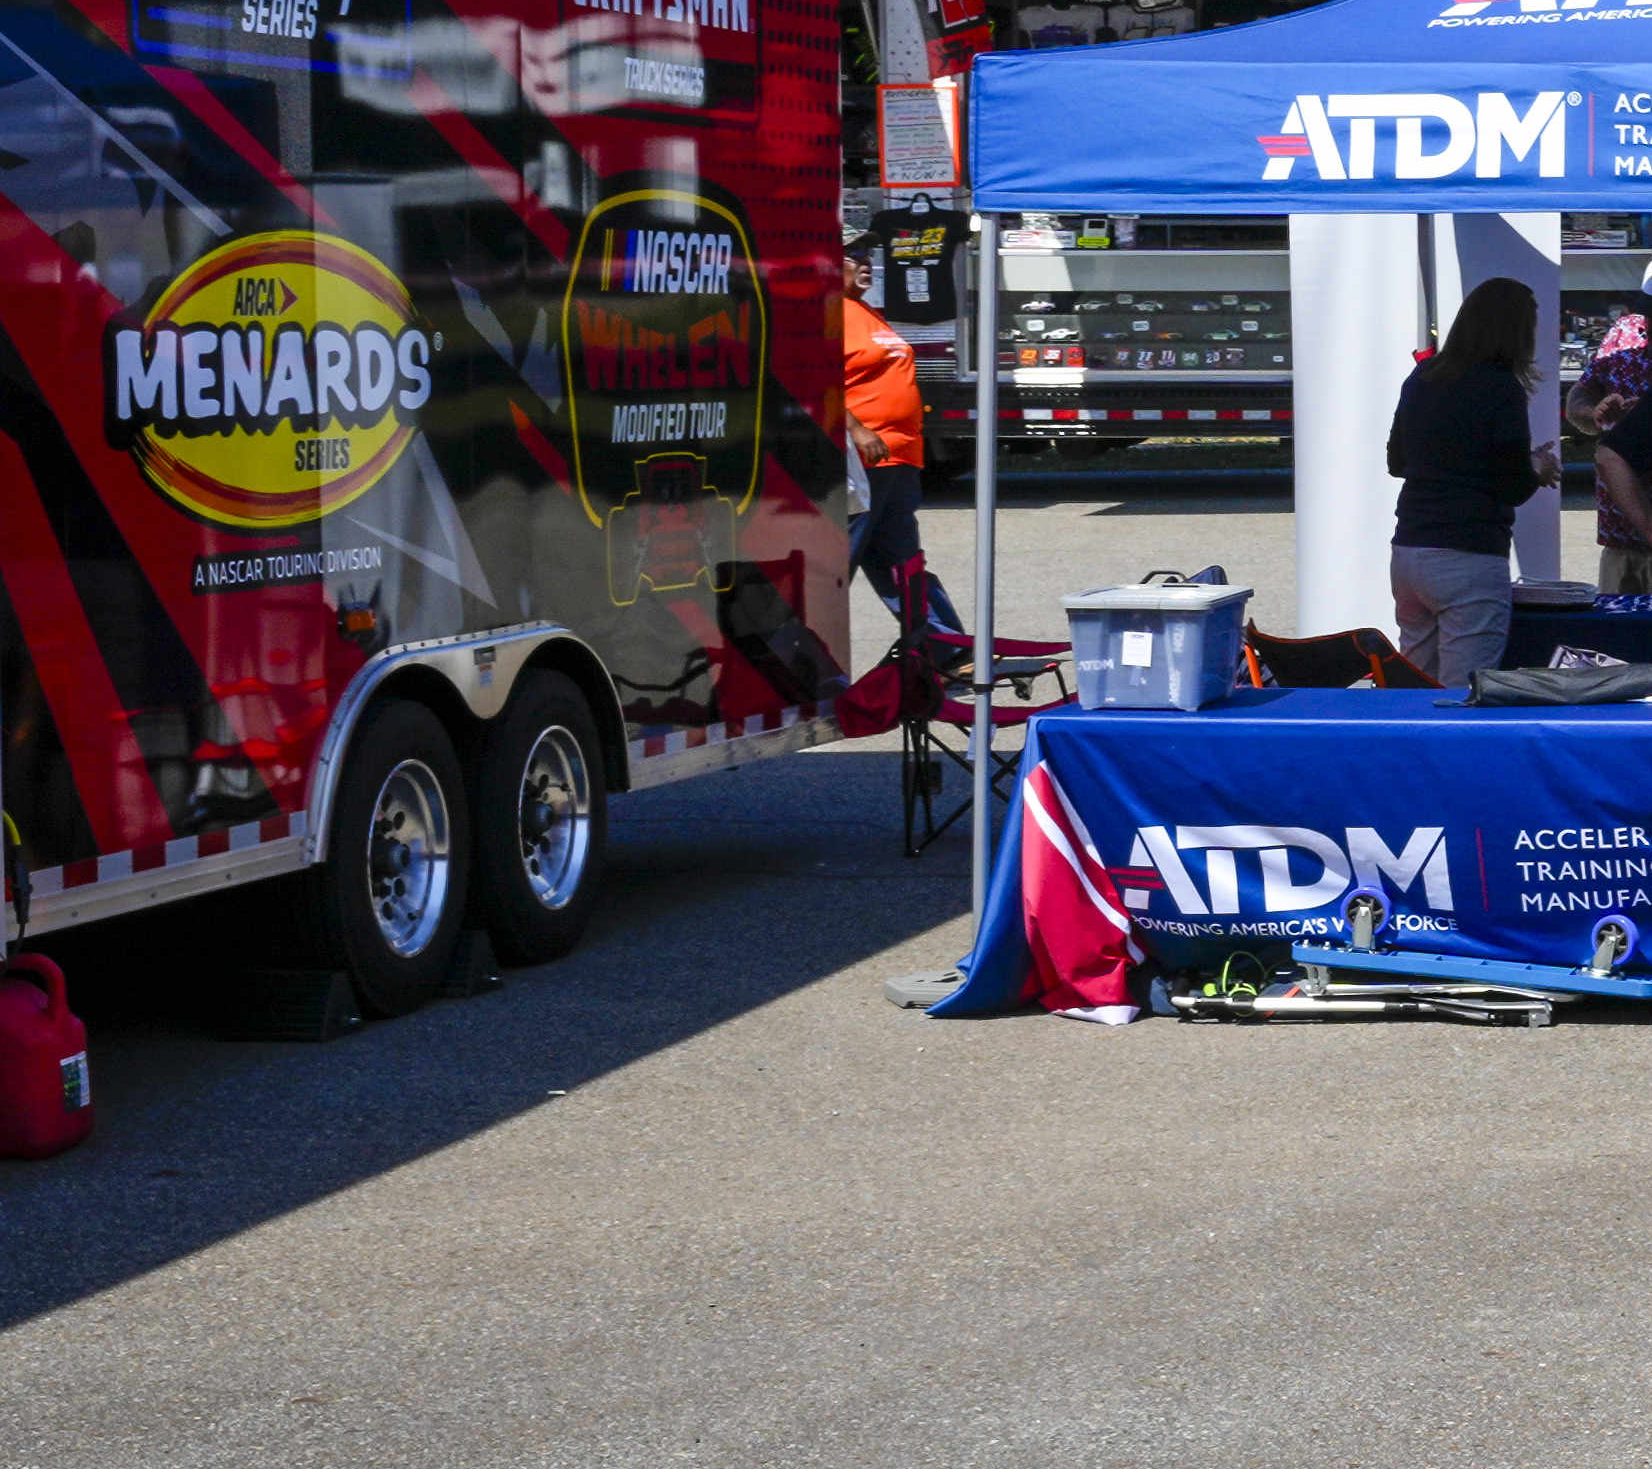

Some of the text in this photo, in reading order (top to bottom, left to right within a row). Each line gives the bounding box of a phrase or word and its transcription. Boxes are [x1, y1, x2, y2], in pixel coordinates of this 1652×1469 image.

[1426, 11, 1562, 29] POWERING
[623, 57, 705, 98] TRUCK SERIES
[1258, 90, 1567, 182] ATDM
[632, 229, 733, 294] NASCAR
[233, 277, 277, 317] ARCA
[576, 299, 751, 391] WHELEN
[115, 329, 433, 421] MENARDS
[610, 401, 727, 444] MODIFIED TOUR
[294, 438, 350, 472] SERIES
[194, 546, 382, 587] A NASCAR TOURING DIVISION
[1110, 824, 1455, 916] ATDM
[1133, 914, 1224, 938] POWERING
[1229, 917, 1328, 937] AMERICA'S
